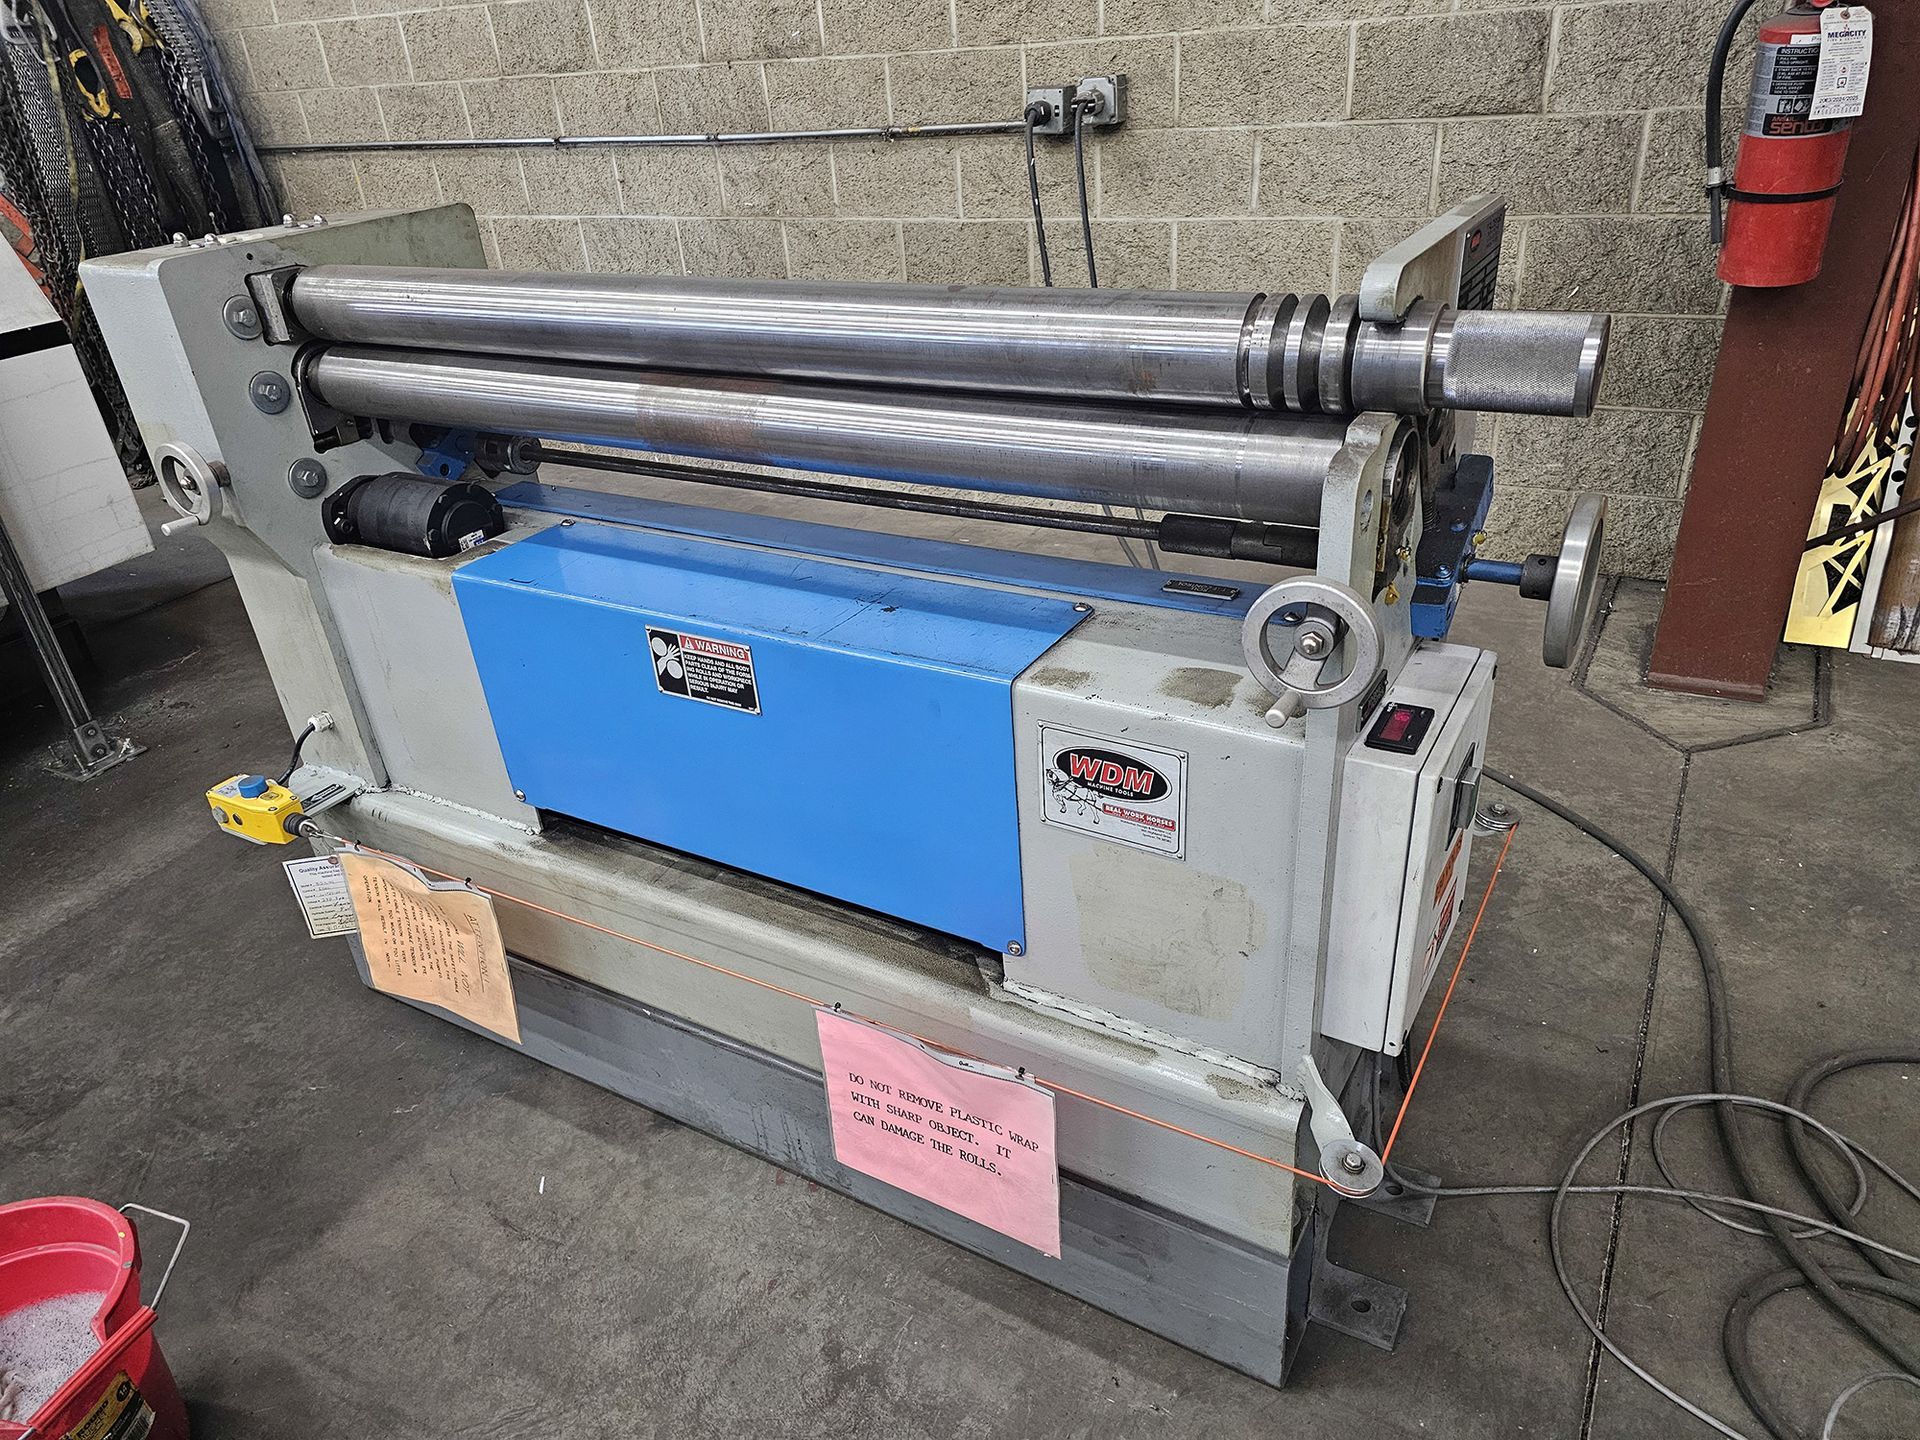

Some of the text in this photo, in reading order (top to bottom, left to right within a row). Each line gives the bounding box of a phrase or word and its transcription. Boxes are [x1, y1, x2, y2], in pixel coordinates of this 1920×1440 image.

[1828, 30, 1866, 38] MEGACITY
[695, 640, 745, 658] WARNING
[698, 656, 714, 664] HANDS
[701, 664, 718, 672] CLEAR
[688, 678, 709, 688] SERIOUS
[710, 683, 727, 691] INJURY
[709, 677, 736, 688] OPERATION
[723, 674, 752, 685] WORKPIECE
[690, 685, 709, 693] RESULT.
[1070, 753, 1154, 795] WDM
[1087, 782, 1134, 797] MACHINE TOOLS
[1123, 810, 1145, 820] WORK
[1146, 814, 1173, 827] HORSES
[363, 875, 372, 903] OPERATION
[467, 914, 490, 984] ATTENTION!
[457, 940, 470, 996] WILL NOT
[849, 1072, 1039, 1152] DO NOT REMOVE PLASTIC WRAP
[851, 1091, 1011, 1160] WITH SHARP OBJECT. IT
[853, 1111, 1002, 1177] CAN DAMAGE THE ROLLS.
